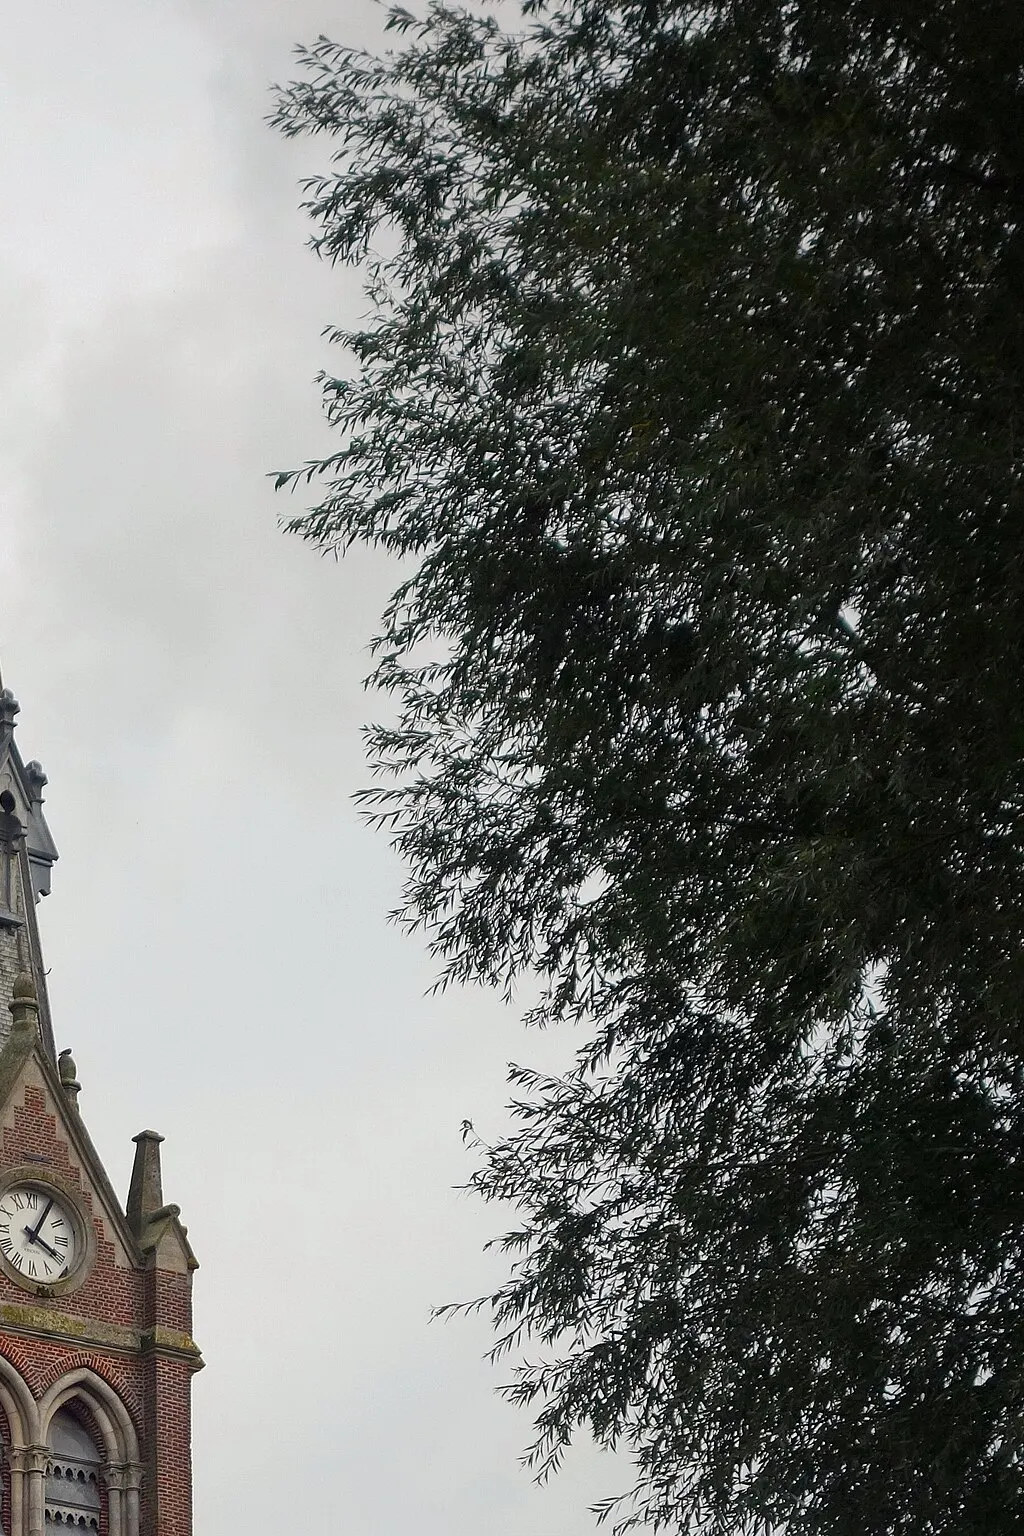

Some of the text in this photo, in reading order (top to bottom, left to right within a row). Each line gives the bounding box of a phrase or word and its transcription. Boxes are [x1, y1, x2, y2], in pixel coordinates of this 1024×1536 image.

[10, 1193, 24, 1211] XI
[25, 1192, 38, 1210] XII
[0, 1205, 14, 1219] X
[51, 1218, 64, 1228] II
[55, 1236, 68, 1247] III
[43, 1260, 53, 1275] V
